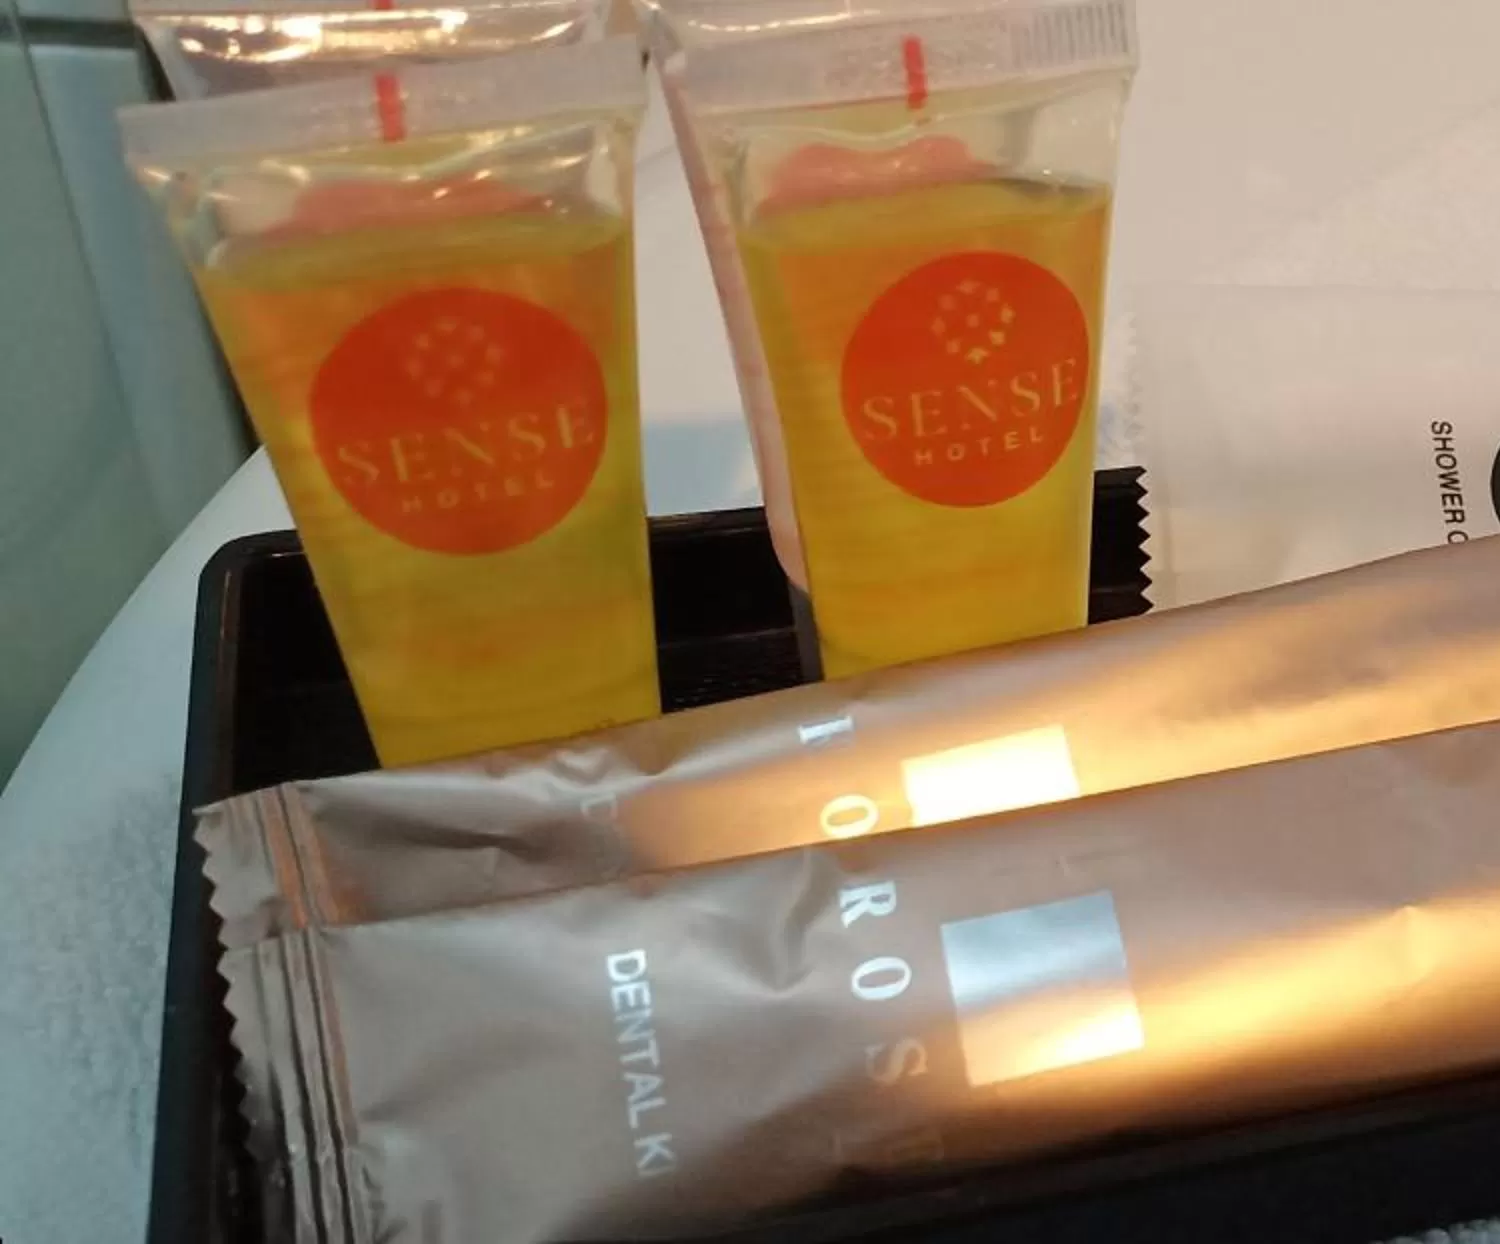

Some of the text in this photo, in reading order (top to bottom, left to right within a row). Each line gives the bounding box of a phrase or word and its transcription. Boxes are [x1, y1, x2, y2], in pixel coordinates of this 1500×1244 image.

[862, 357, 1077, 440] SENSE
[337, 401, 596, 487] SENSE
[914, 425, 1044, 466] HOTEL
[1431, 420, 1466, 524] SHOWER
[402, 468, 554, 513] HOTEL
[606, 948, 667, 1129] DENTAL
